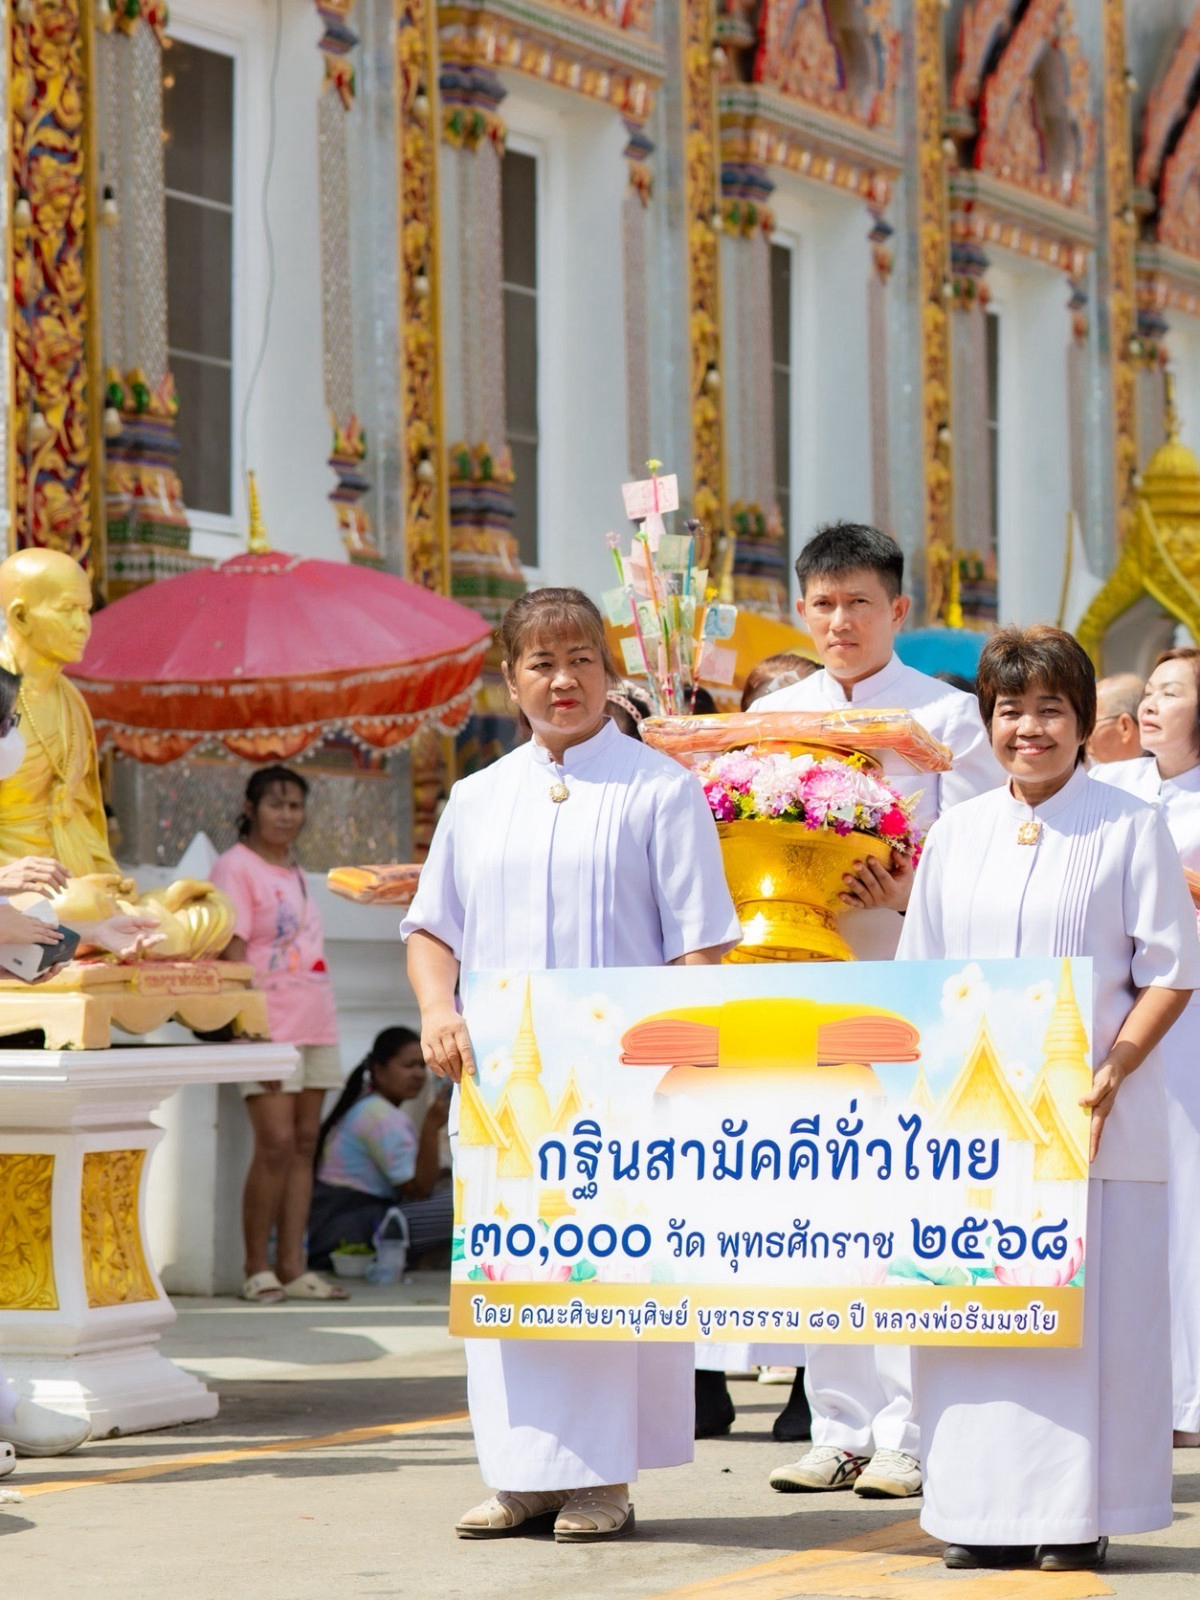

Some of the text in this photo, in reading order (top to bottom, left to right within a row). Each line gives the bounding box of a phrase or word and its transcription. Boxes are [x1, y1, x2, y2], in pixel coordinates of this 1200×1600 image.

[538, 1098, 1000, 1200] กฐินสามัคคีทั่วไทย
[470, 1216, 1068, 1273] ๓๐,๐๐๐ วัด พุทธศักราช ๒๕๖๘
[473, 1298, 1056, 1336] โดย คณะศิษยานุศิษย์ บูชาธรรม ๘๑ ปี หลวงพ่อธัมมชโย
